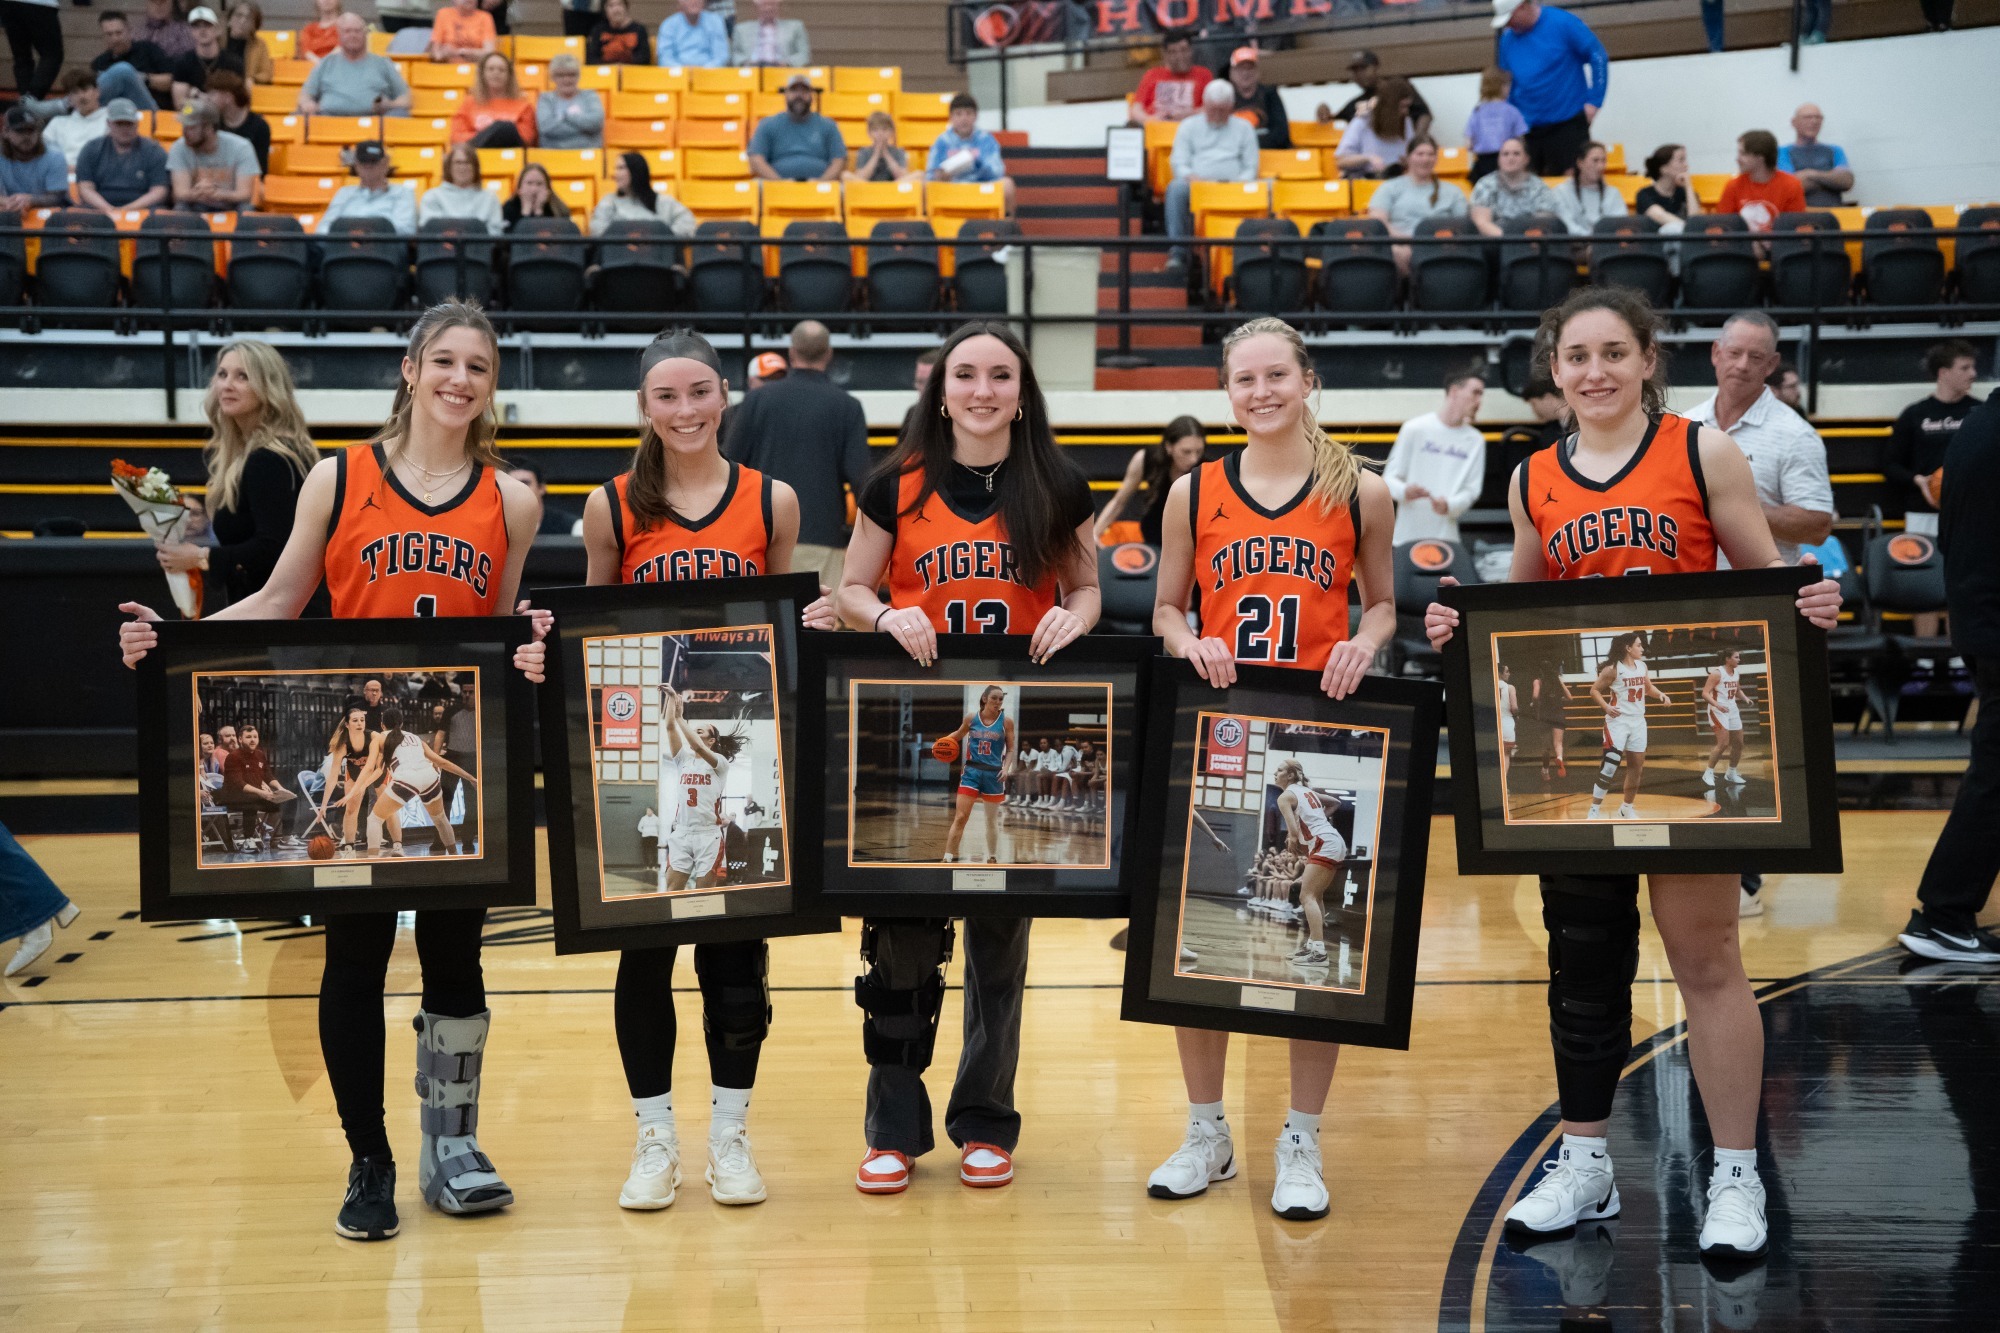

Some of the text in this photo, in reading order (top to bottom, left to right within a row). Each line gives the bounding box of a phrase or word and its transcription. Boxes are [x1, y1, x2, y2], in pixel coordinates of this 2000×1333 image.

[1547, 506, 1678, 578] TIGERS
[361, 531, 492, 598] TIGERS
[914, 540, 1033, 594] TIGER
[1211, 535, 1336, 592] TIGERS
[945, 598, 1010, 634] 13
[1235, 594, 1300, 663] 21
[694, 630, 744, 645] Always
[746, 632, 755, 642] a
[1628, 687, 1643, 702] 24
[1221, 725, 1237, 741] JJ
[686, 787, 698, 807] 3
[1303, 791, 1322, 809] 21
